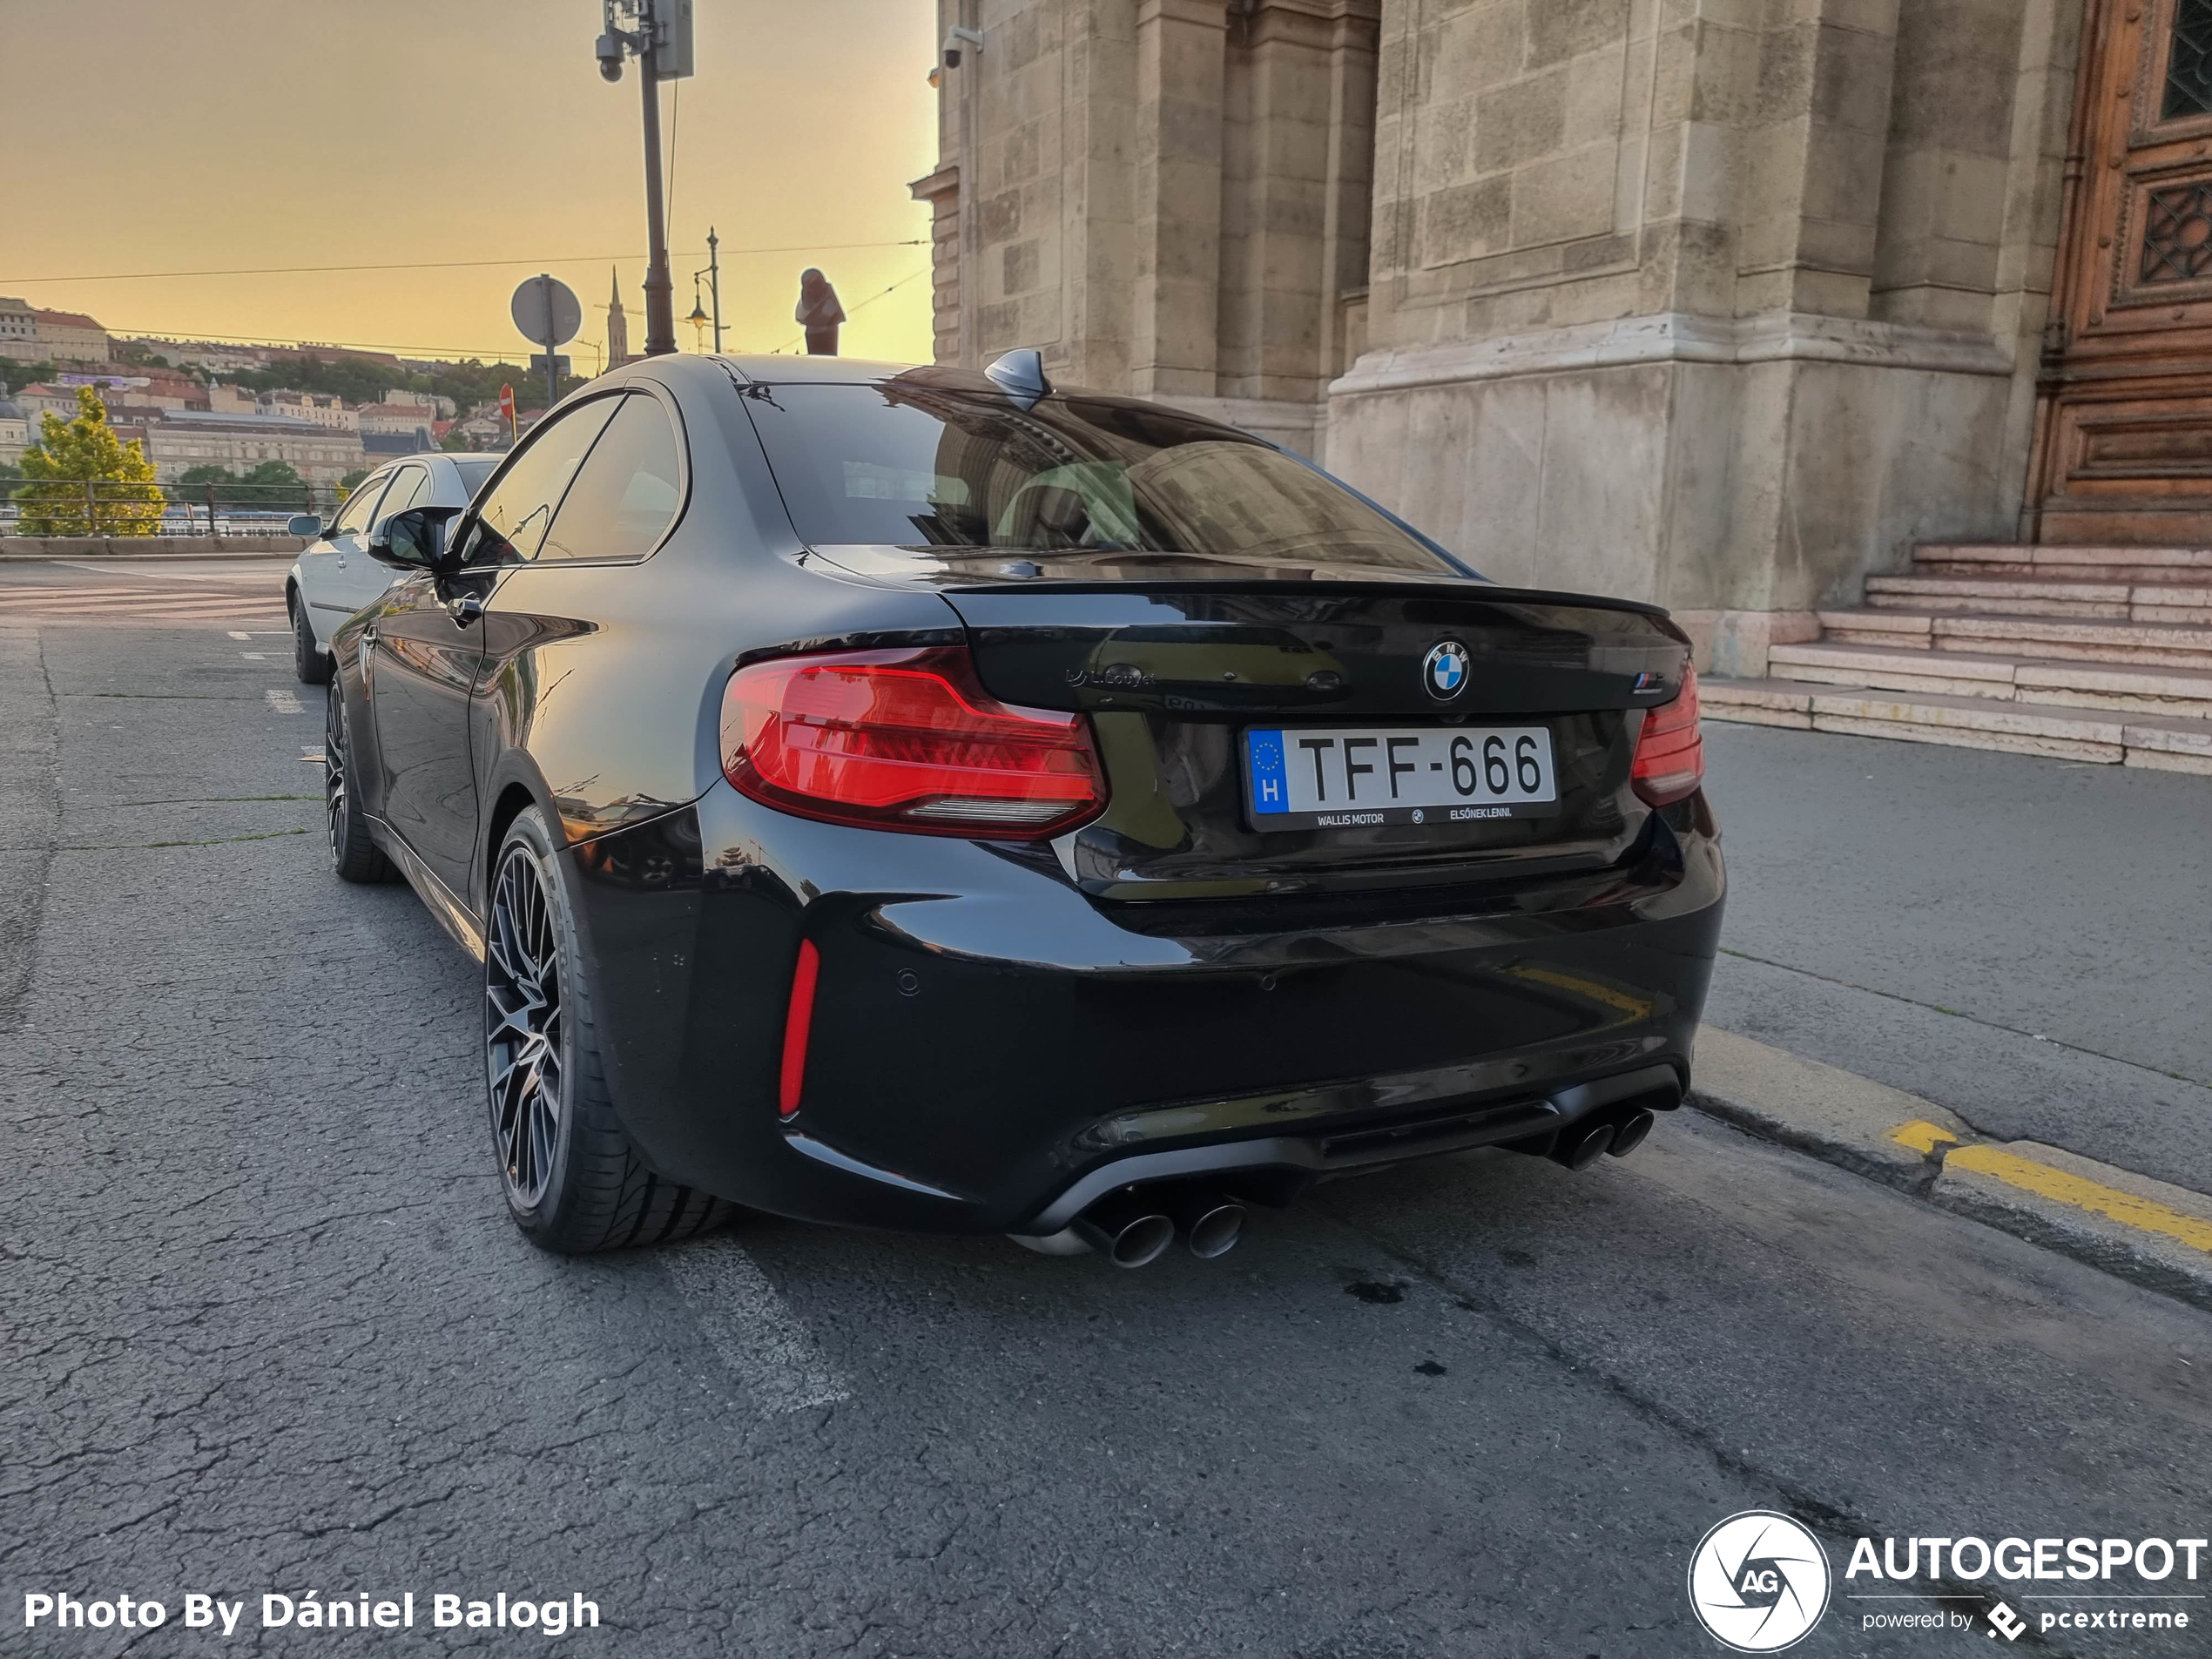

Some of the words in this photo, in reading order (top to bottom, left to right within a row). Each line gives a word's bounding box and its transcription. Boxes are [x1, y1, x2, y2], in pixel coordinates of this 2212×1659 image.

[1433, 644, 1468, 663] BMW
[1298, 735, 1541, 801] TFF-666
[1262, 779, 1278, 802] H
[1318, 814, 1351, 826] WALLIS
[1352, 813, 1385, 825] MOTOR
